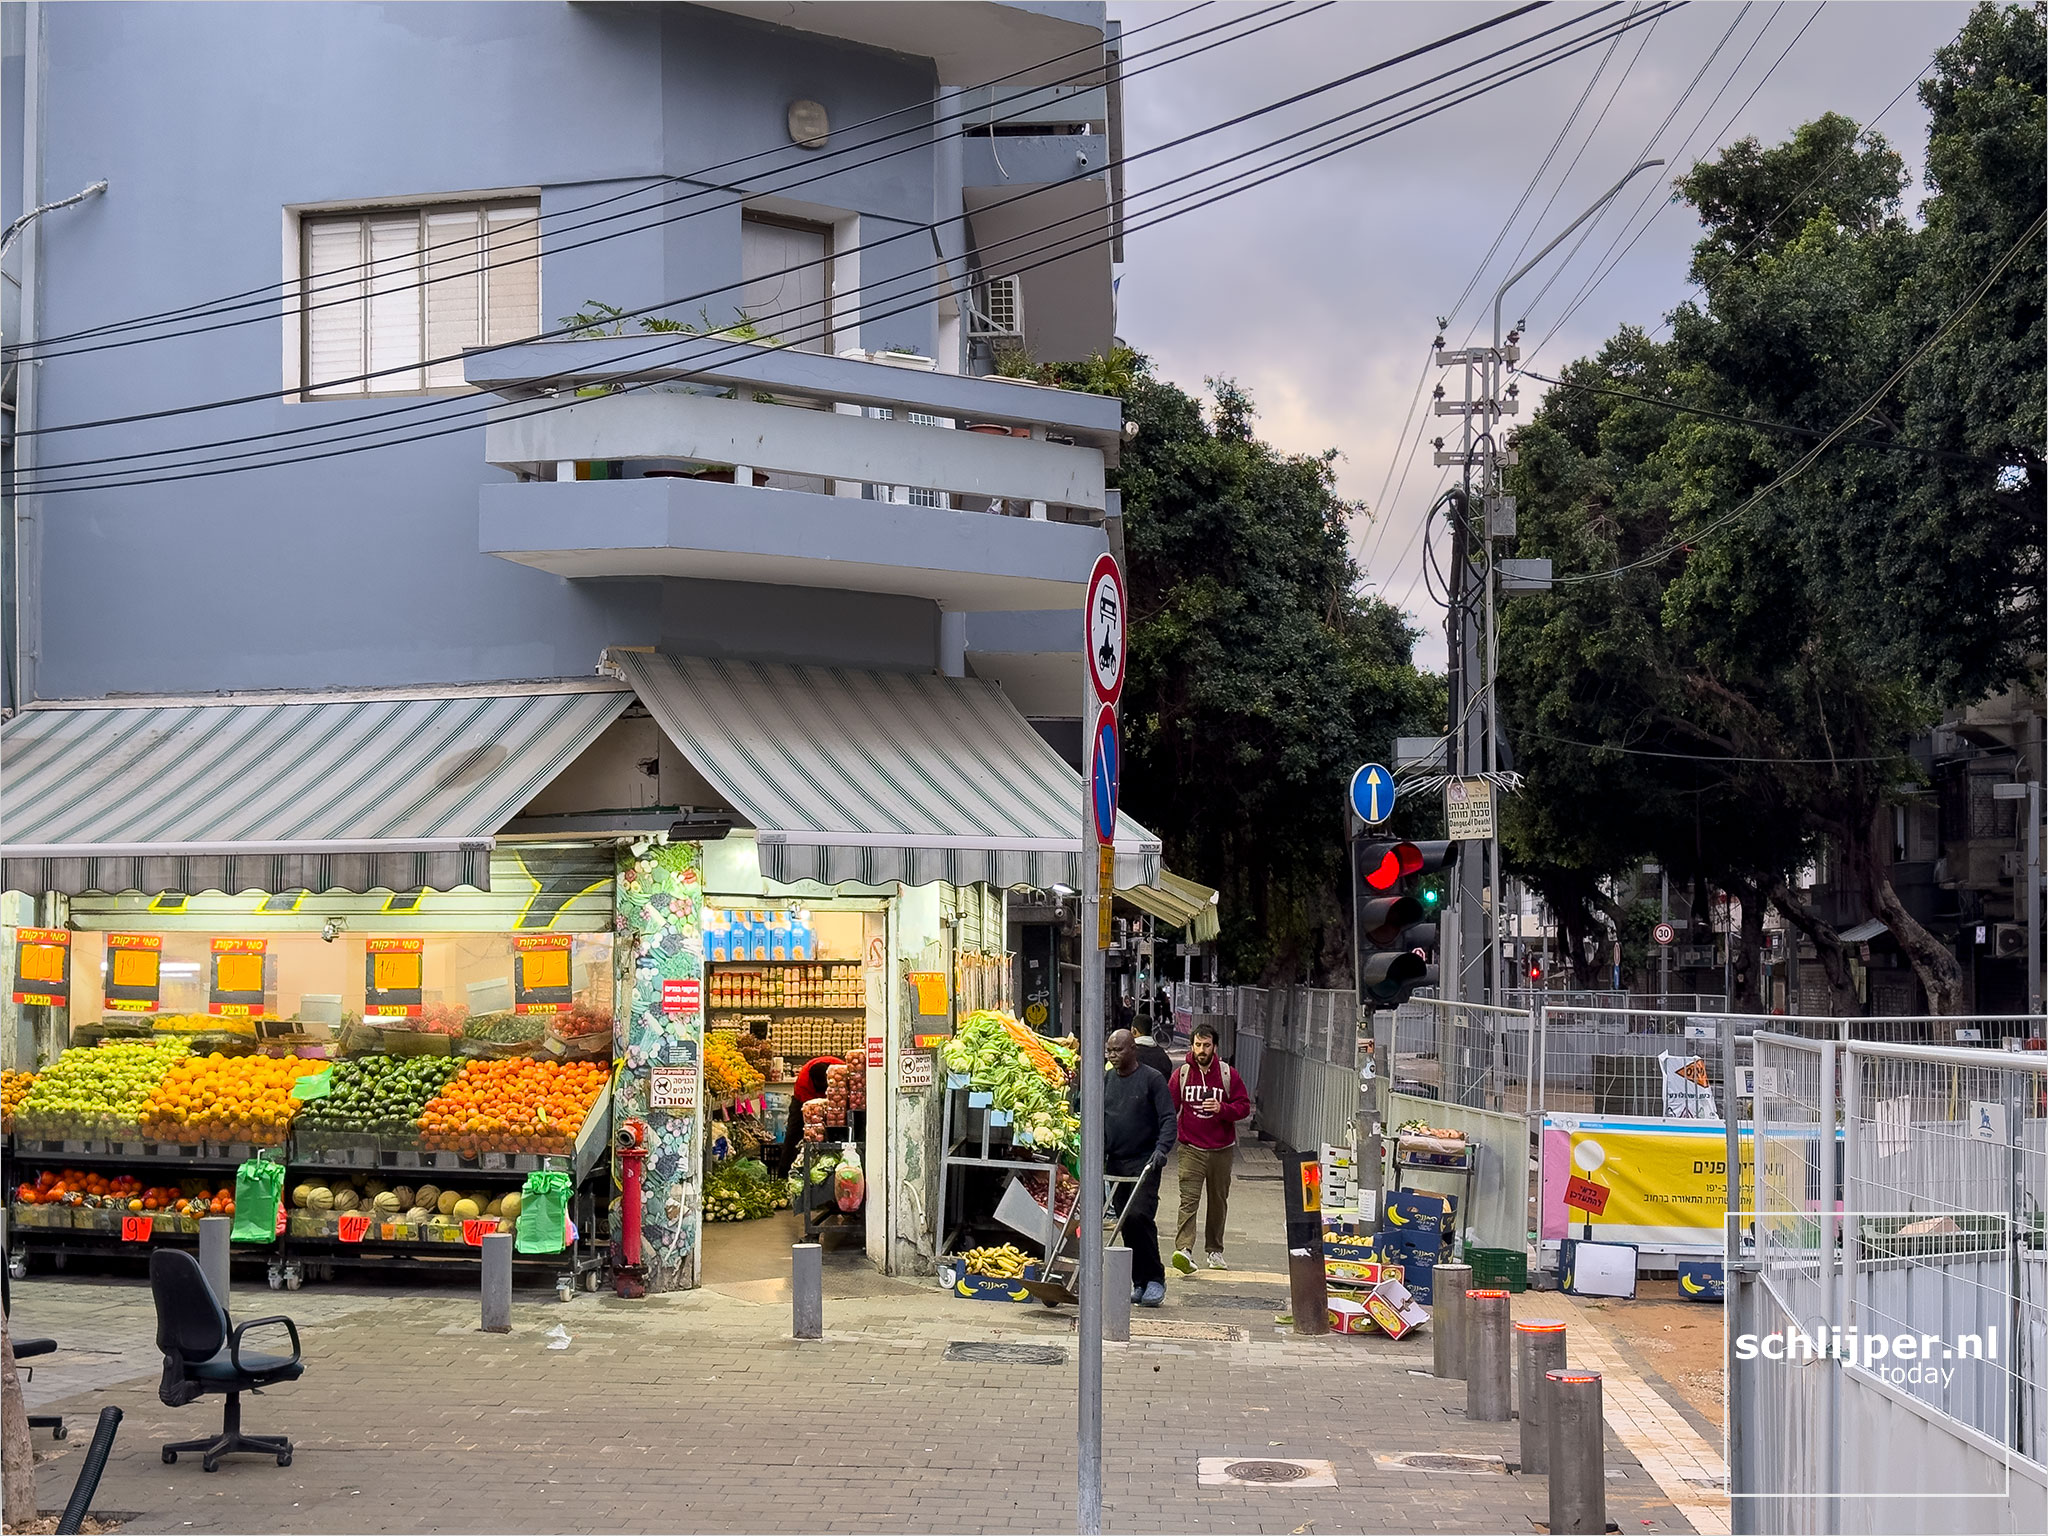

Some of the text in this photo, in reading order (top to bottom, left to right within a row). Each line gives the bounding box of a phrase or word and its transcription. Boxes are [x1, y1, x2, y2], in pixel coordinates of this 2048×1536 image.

[1473, 801, 1489, 809] מתח
[1471, 809, 1489, 817] סכנת
[19, 930, 67, 942] סמי ירקות
[1658, 929, 1669, 938] 30
[111, 935, 160, 947] סמי ירקות
[214, 940, 263, 950] סמי ירקות
[370, 940, 420, 950] סמי ירקות
[518, 937, 569, 949] סמי ירקות
[23, 994, 51, 1006] מבצע
[220, 1005, 249, 1016] מבצע
[378, 1005, 408, 1016] מבצע
[673, 1077, 694, 1085] הכניסה
[902, 1075, 930, 1084] אסורה!
[673, 1086, 694, 1094] לכלבים
[654, 1096, 693, 1105] אסורה!
[1693, 1161, 1726, 1174] פנים
[1580, 1186, 1598, 1197] כדאי
[1569, 1190, 1602, 1207] להתעדכן
[1644, 1194, 1669, 1203] ברחוב
[1672, 1195, 1703, 1204] התאורה
